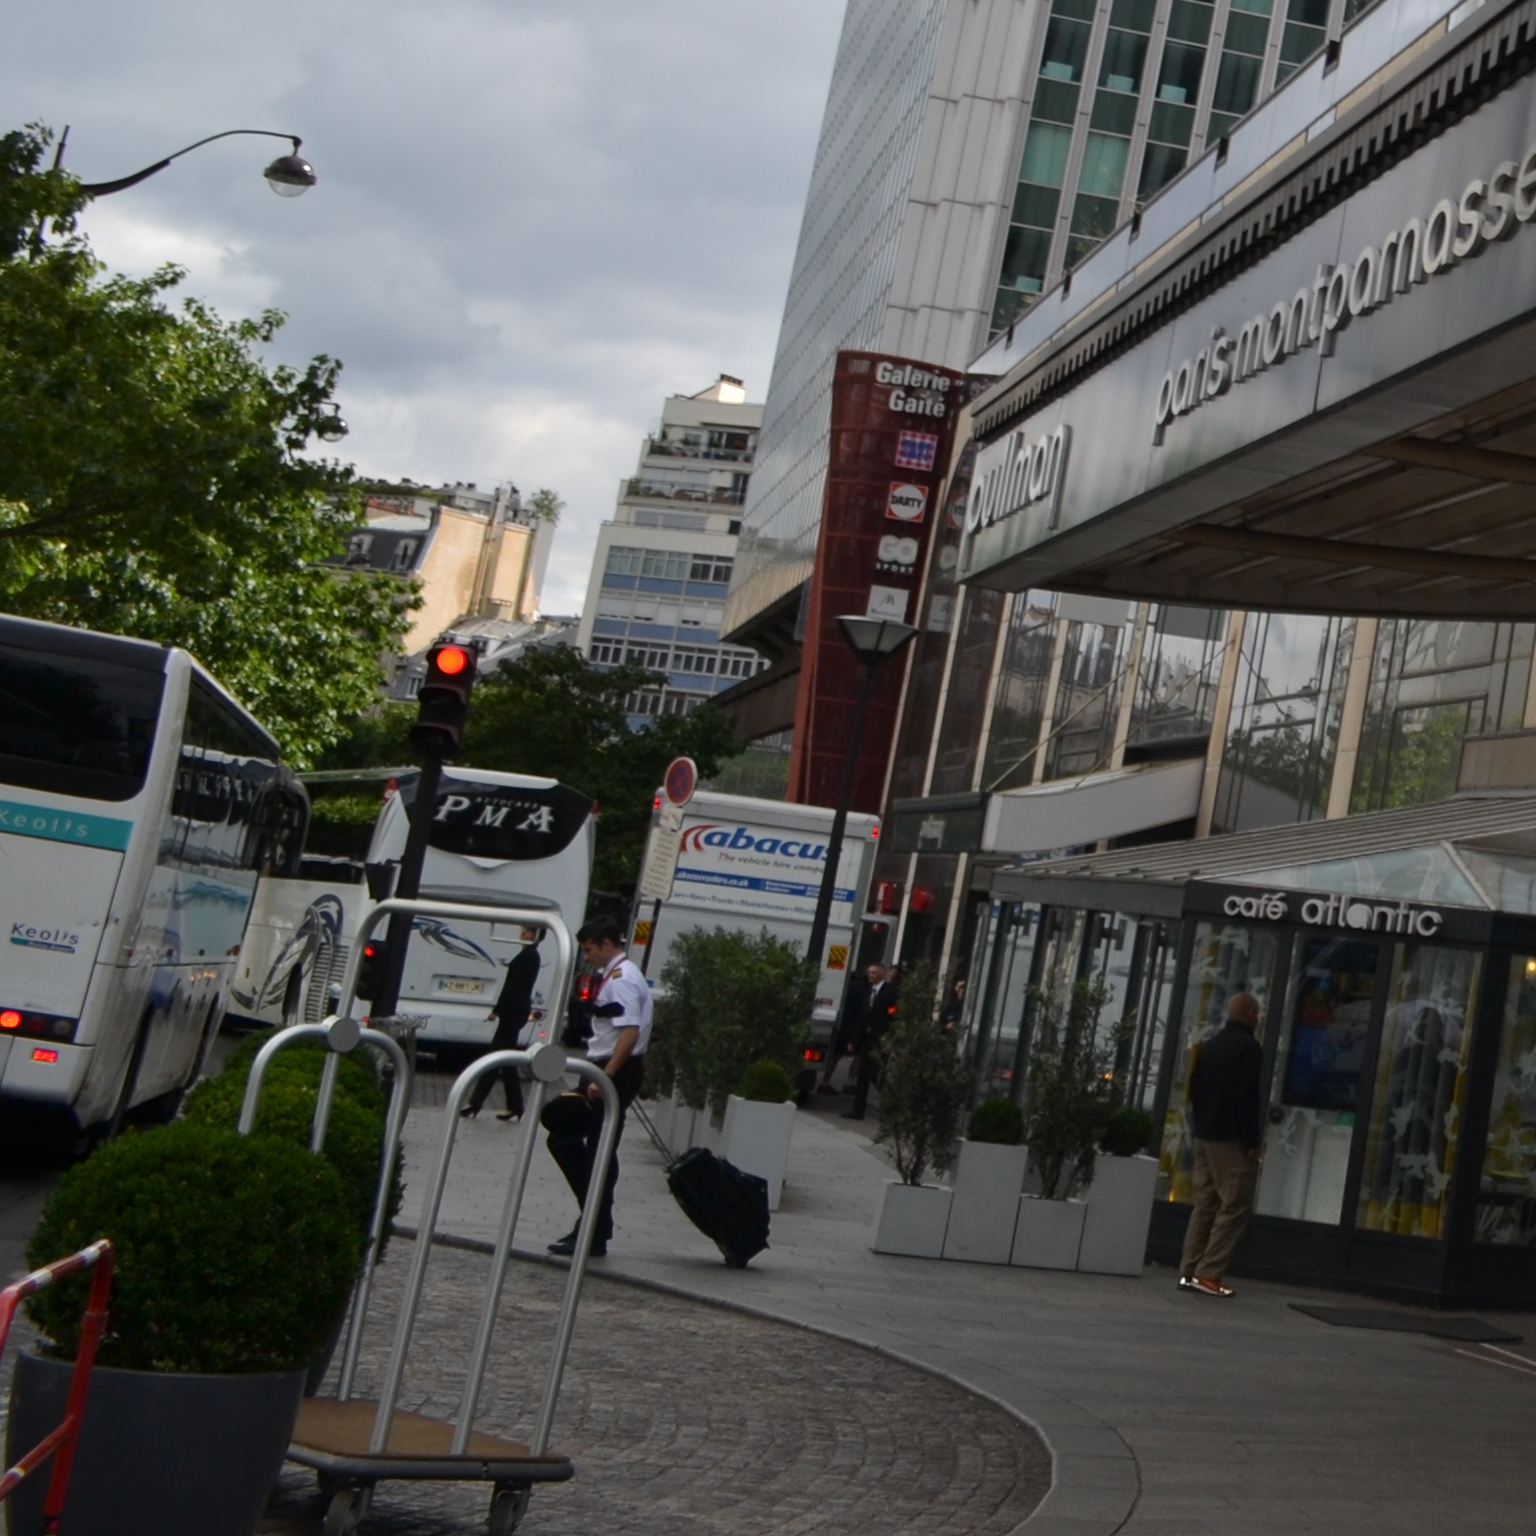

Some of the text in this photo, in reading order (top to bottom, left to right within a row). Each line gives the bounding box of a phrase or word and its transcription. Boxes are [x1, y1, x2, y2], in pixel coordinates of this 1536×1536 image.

[876, 361, 951, 392] Galerie
[960, 424, 1073, 572] pullman
[1152, 324, 1236, 446] paris
[890, 495, 924, 510] DARTY
[878, 535, 919, 564] GO
[875, 562, 915, 574] SPORT
[474, 797, 539, 810] AUTOCARS
[0, 809, 88, 838] Keolis
[718, 852, 825, 875] The vehicle hire comp
[1223, 891, 1443, 937] café atlantic
[11, 923, 79, 946] Keolis
